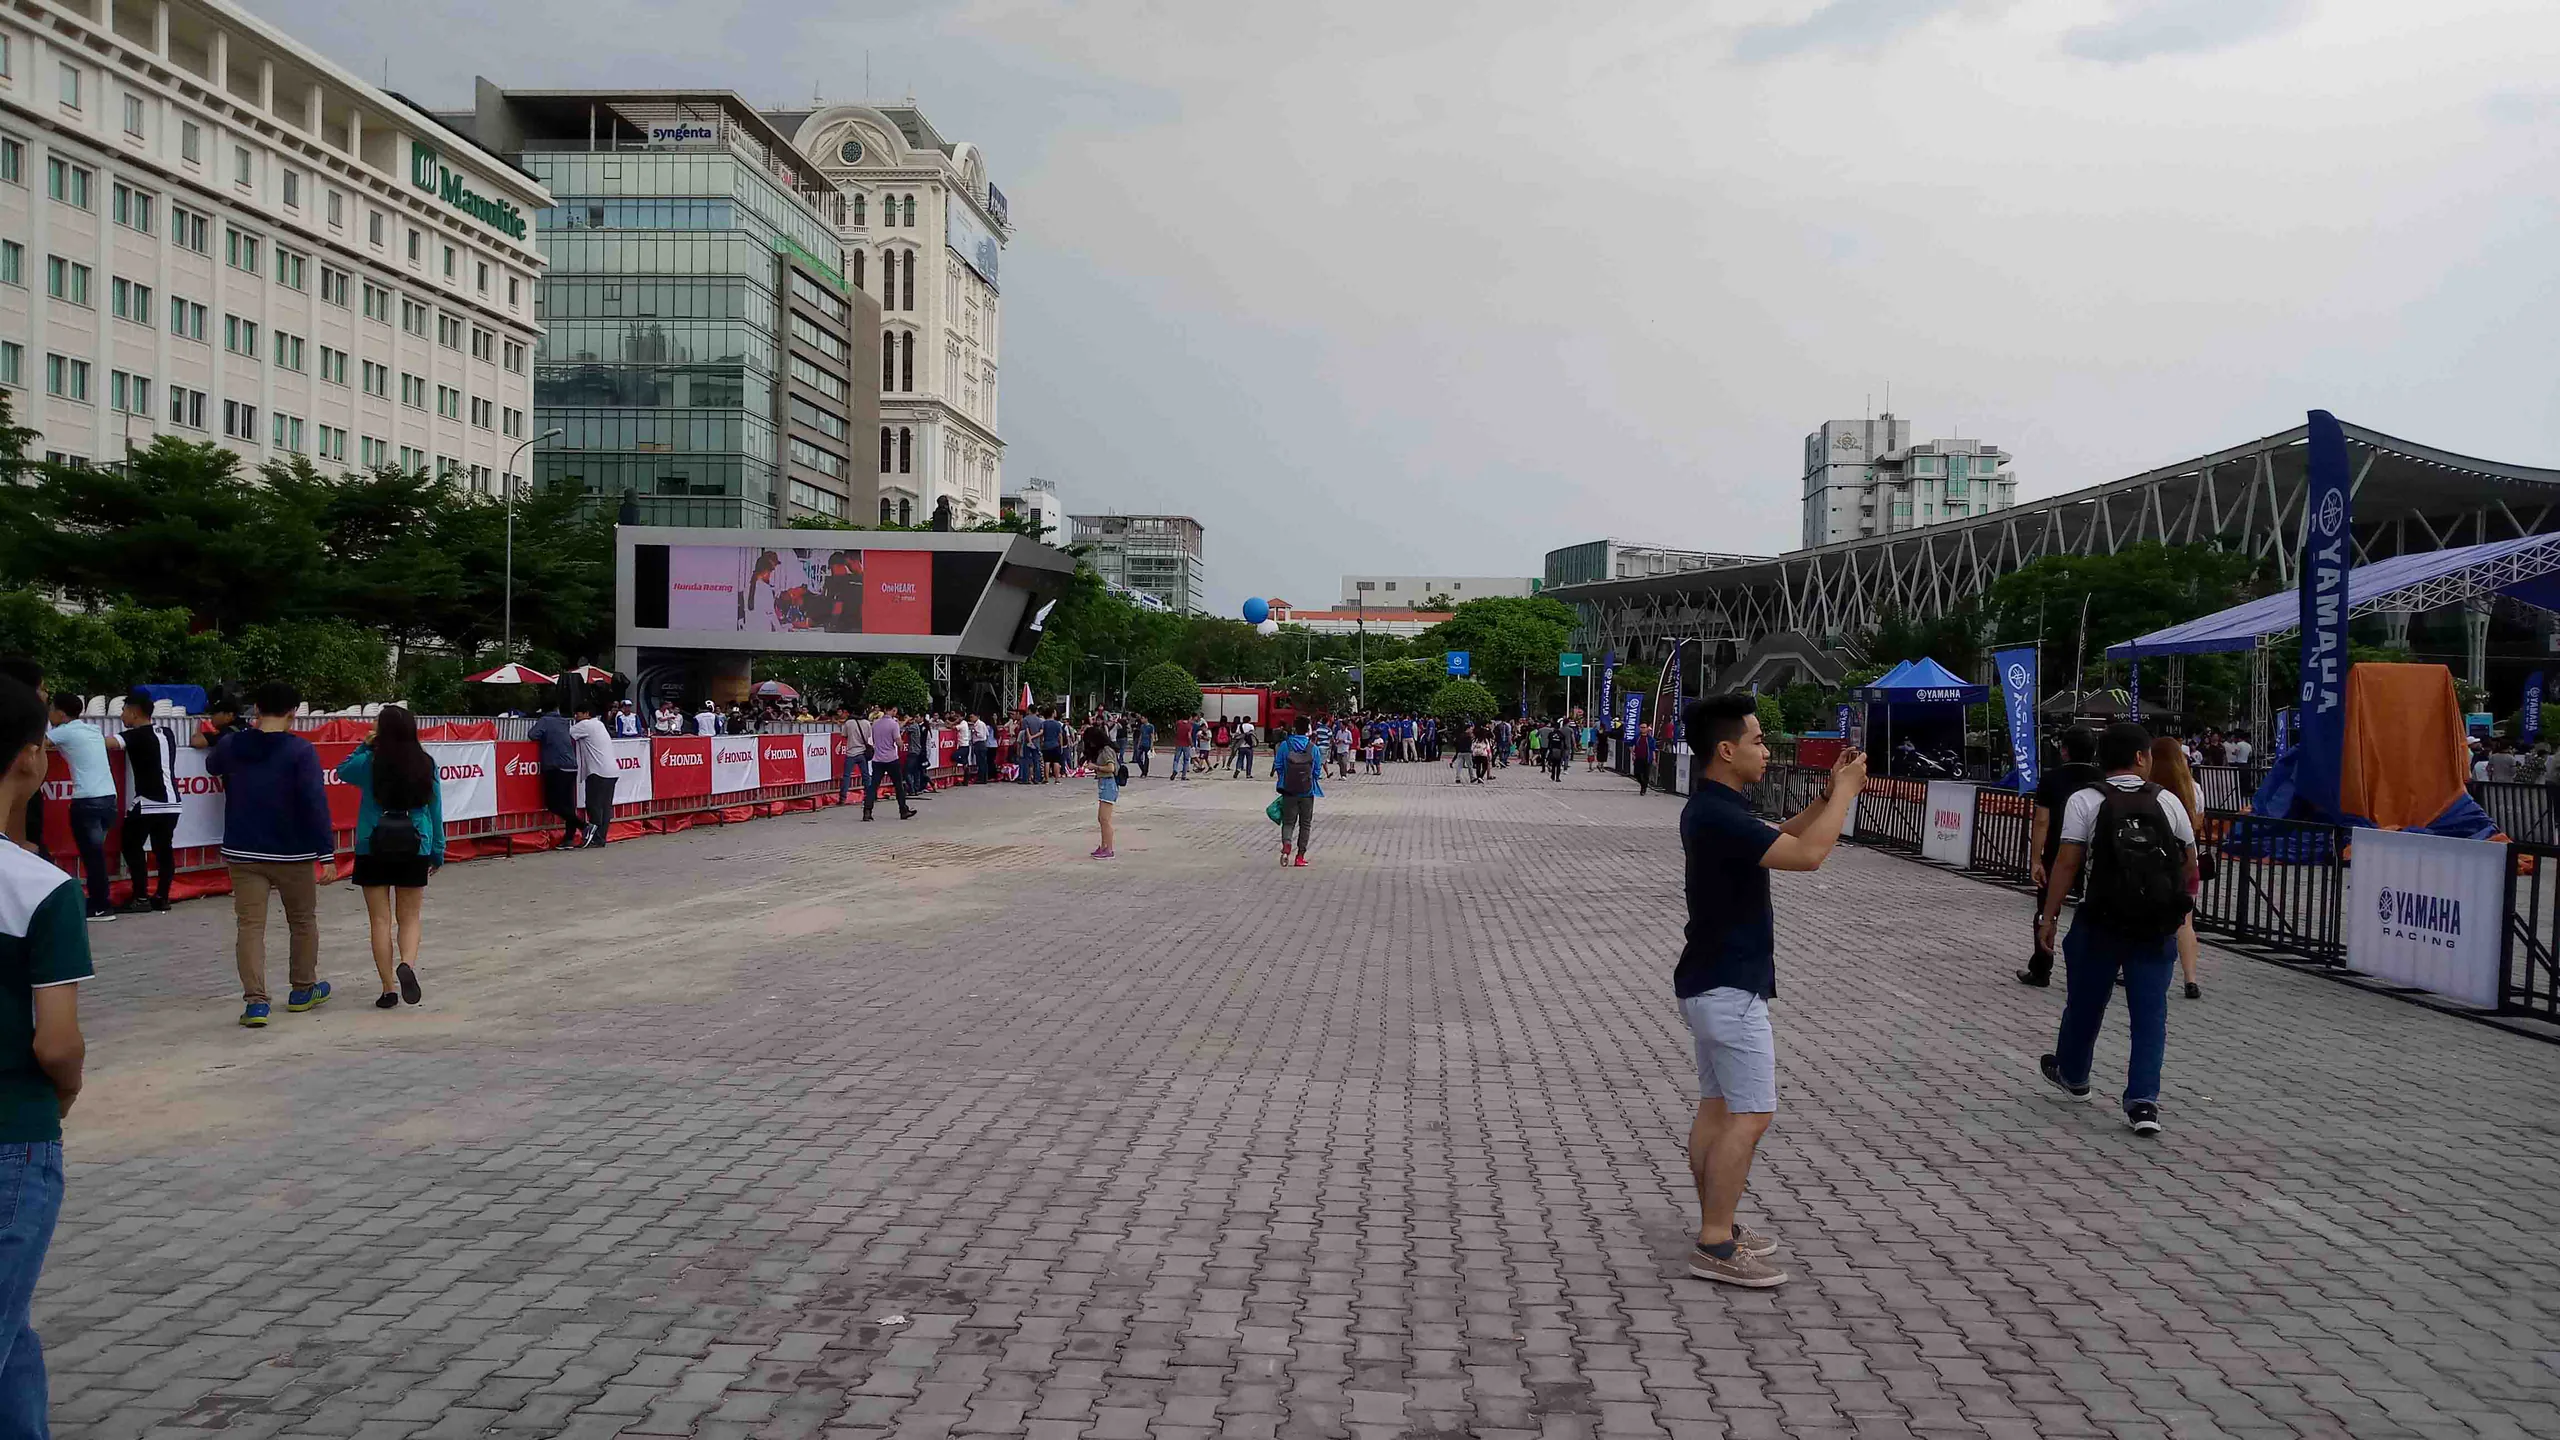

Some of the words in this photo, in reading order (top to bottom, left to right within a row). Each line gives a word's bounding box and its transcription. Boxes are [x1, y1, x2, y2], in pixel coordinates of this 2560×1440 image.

[653, 126, 712, 141] syngenta
[439, 165, 526, 241] Manulife
[2316, 537, 2342, 715] YAMAHA
[1926, 689, 1961, 699] YAMAHA
[2113, 712, 2150, 720] MONER
[2528, 697, 2539, 731] YAMAHA
[1626, 707, 1638, 740] YAMAHA
[724, 751, 753, 764] HONDA
[771, 748, 798, 760] HONDA
[811, 746, 828, 757] HONDA
[616, 757, 641, 770] NDA
[669, 753, 703, 766] HONDA
[438, 764, 484, 780] ONDA
[173, 776, 224, 796] HON
[2396, 891, 2461, 936] YAMAHA
[2383, 927, 2456, 949] RACING
